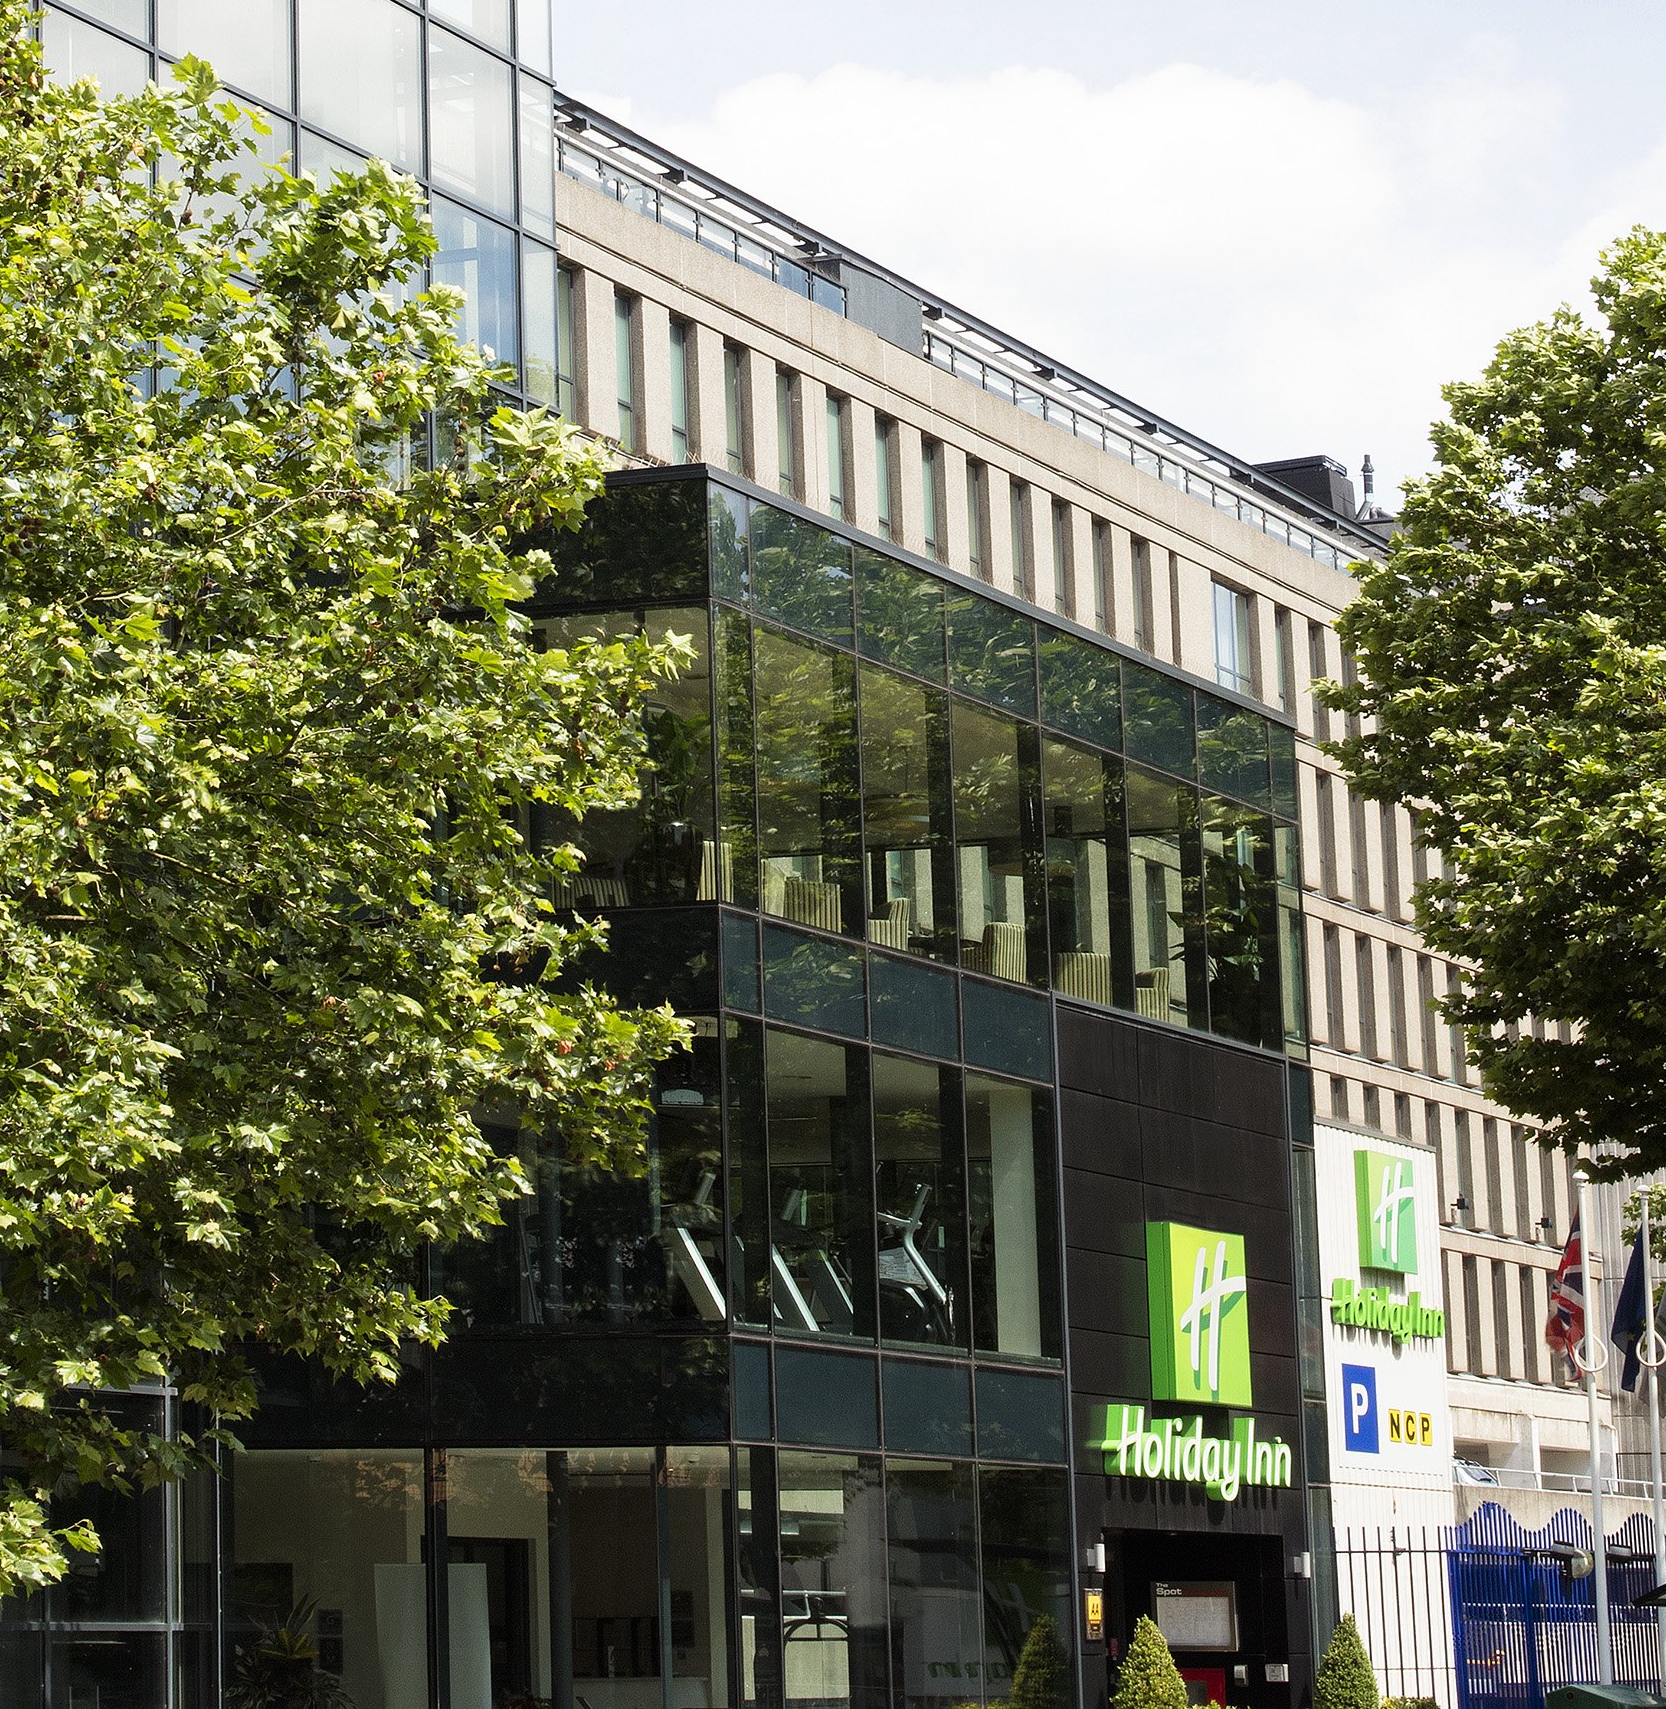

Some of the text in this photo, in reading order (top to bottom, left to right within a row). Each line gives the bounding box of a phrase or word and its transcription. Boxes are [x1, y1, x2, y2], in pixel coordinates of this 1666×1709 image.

[1333, 1279, 1446, 1344] Holiday Inn
[1351, 1382, 1368, 1433] P
[1389, 1412, 1432, 1445] NCP
[1113, 1404, 1292, 1501] Holiday Inn
[1156, 1588, 1182, 1596] Spot
